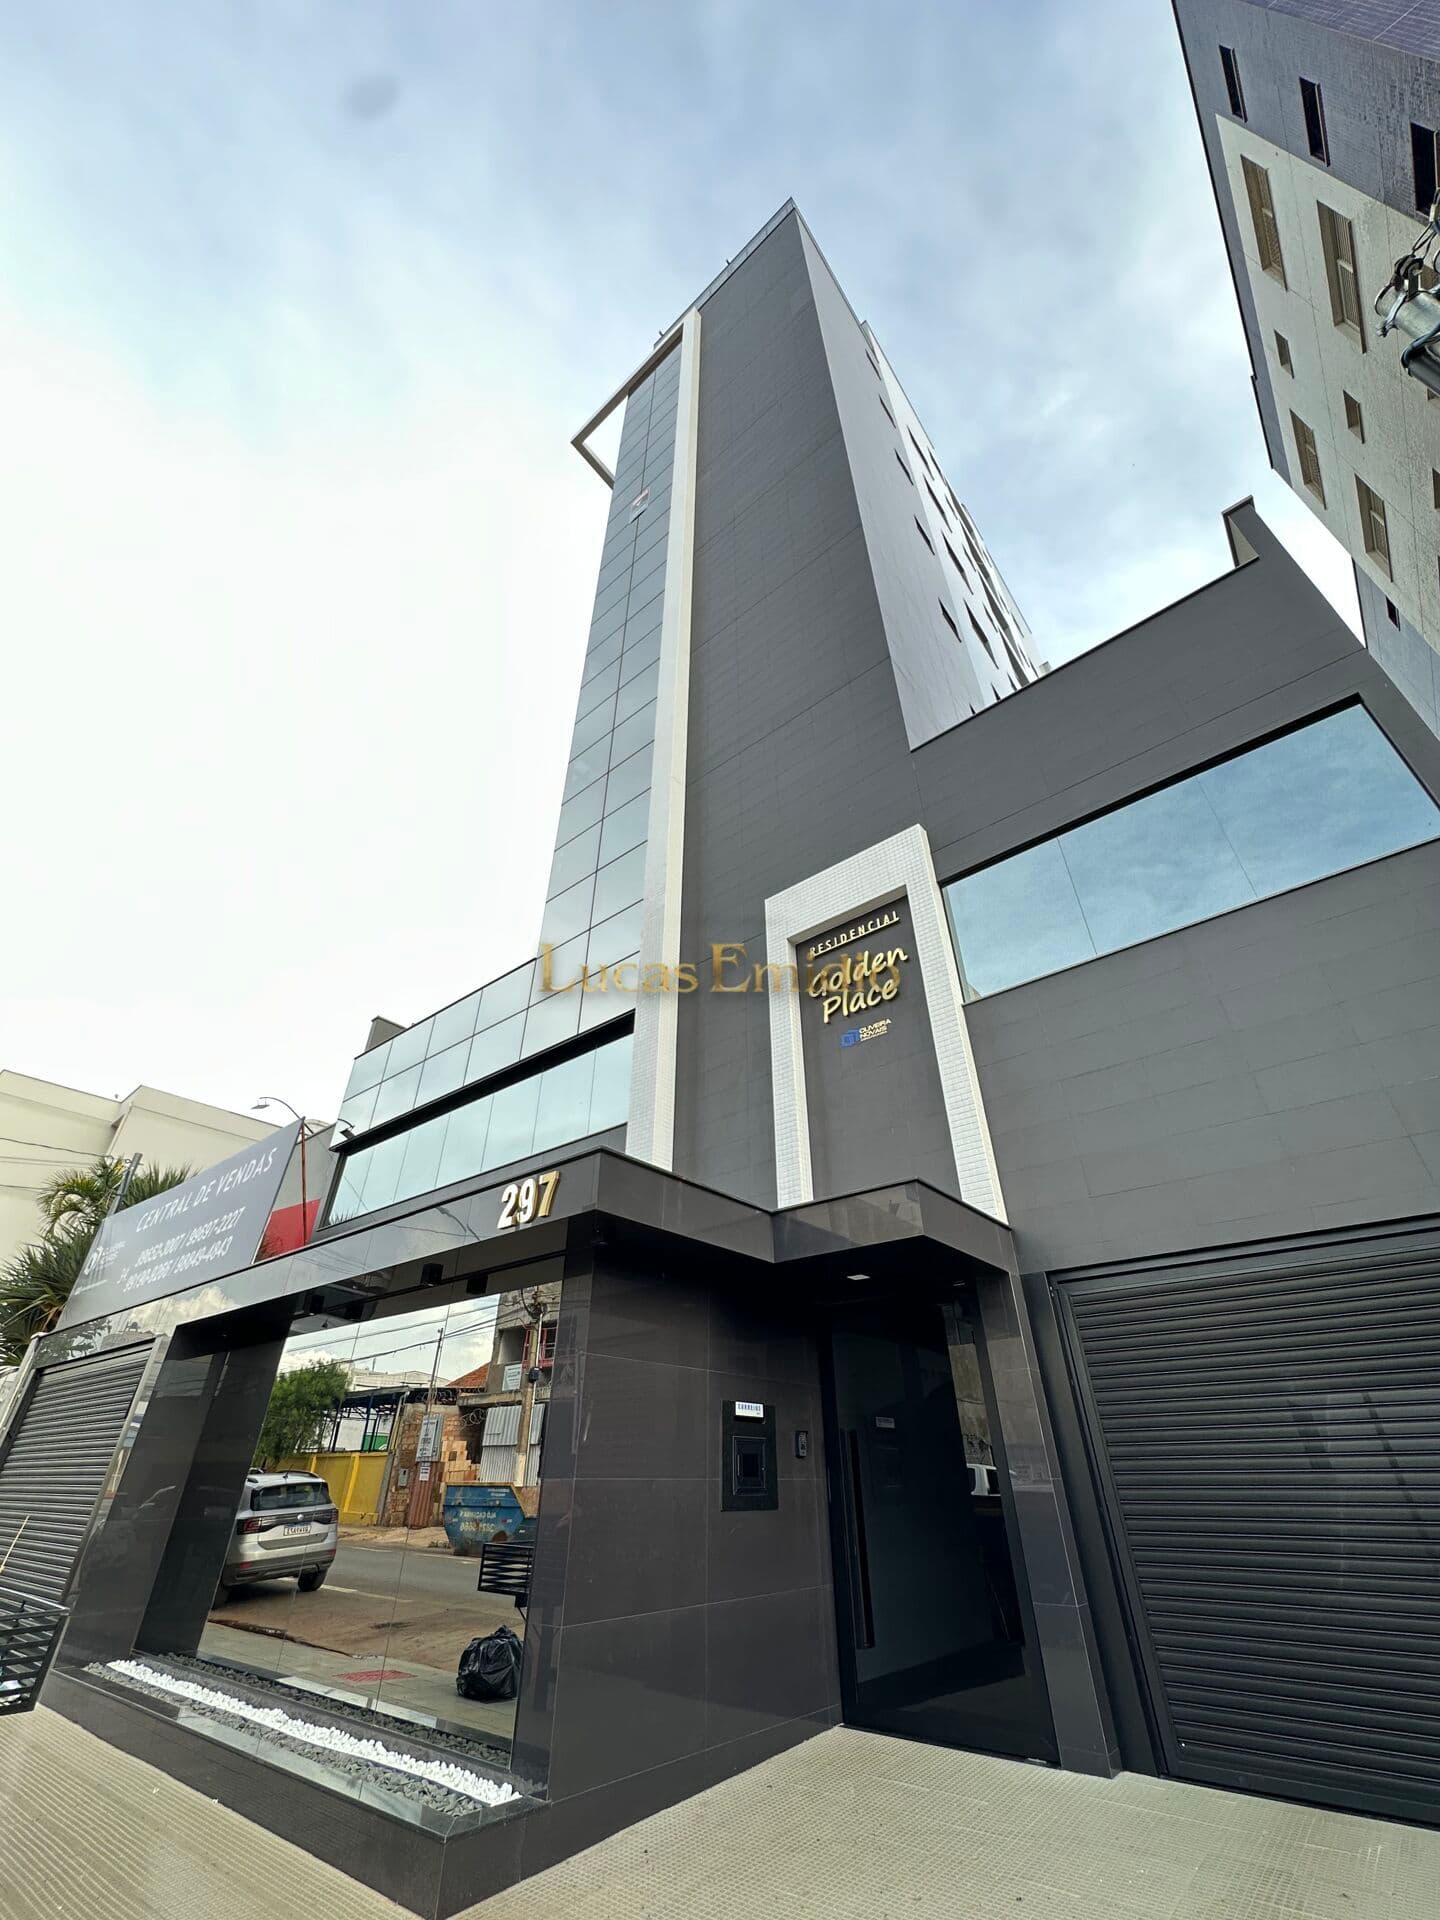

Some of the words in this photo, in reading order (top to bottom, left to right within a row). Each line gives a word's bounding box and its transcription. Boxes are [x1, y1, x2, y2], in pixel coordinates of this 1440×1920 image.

[809, 910, 900, 957] RESIDENCIAL
[809, 947, 909, 997] Golden
[822, 979, 898, 1024] Place
[136, 1191, 192, 1233] CENTRAL
[193, 1179, 216, 1207] DE
[215, 1147, 277, 1197] VENDAS
[497, 1170, 560, 1229] 297
